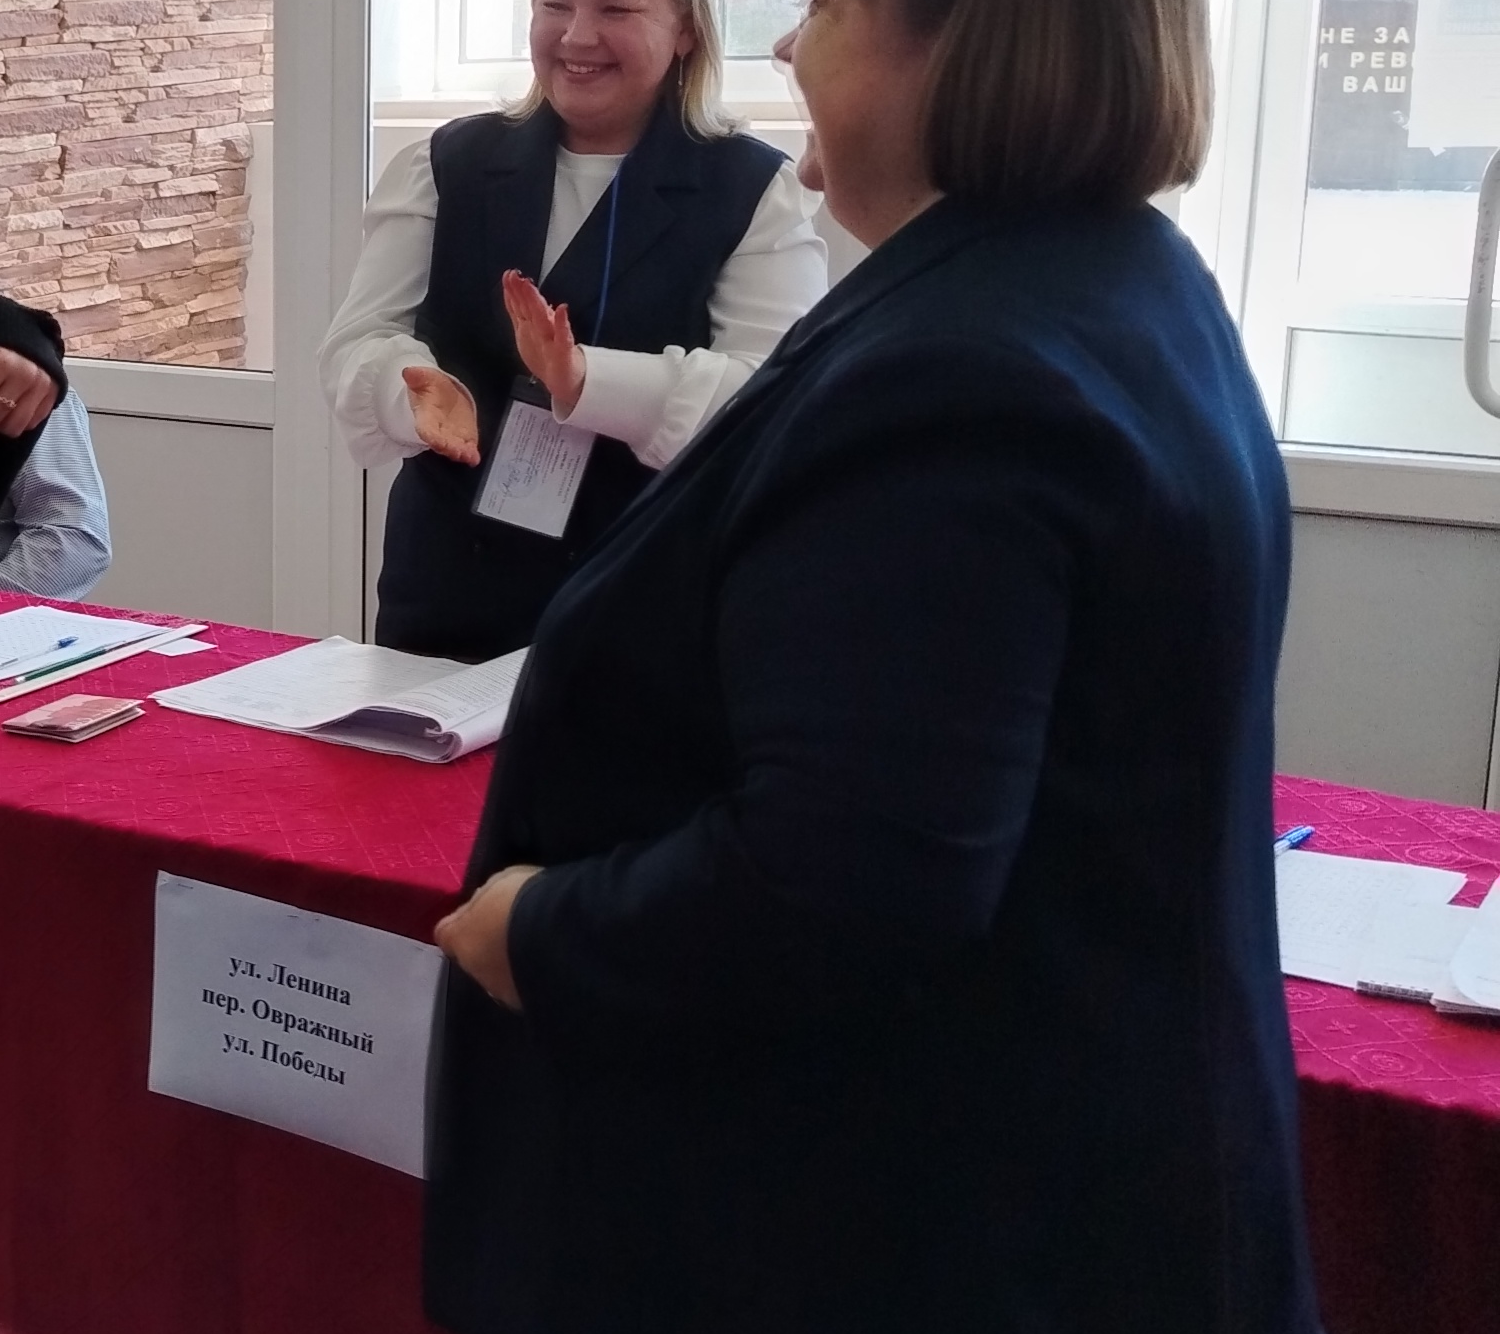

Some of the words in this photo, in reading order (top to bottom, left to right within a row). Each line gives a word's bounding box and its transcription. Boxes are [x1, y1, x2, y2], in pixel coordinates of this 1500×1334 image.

[1320, 27, 1355, 44] НЕ
[1374, 26, 1410, 44] ЗА
[1350, 51, 1411, 69] РЕВ
[1343, 75, 1406, 93] ВАШ
[228, 957, 262, 977] ул.
[267, 963, 351, 1006] Ленина
[202, 988, 246, 1016] пер.
[252, 998, 374, 1055] Овражный
[222, 1033, 255, 1054] ул.
[260, 1039, 347, 1086] Победы
